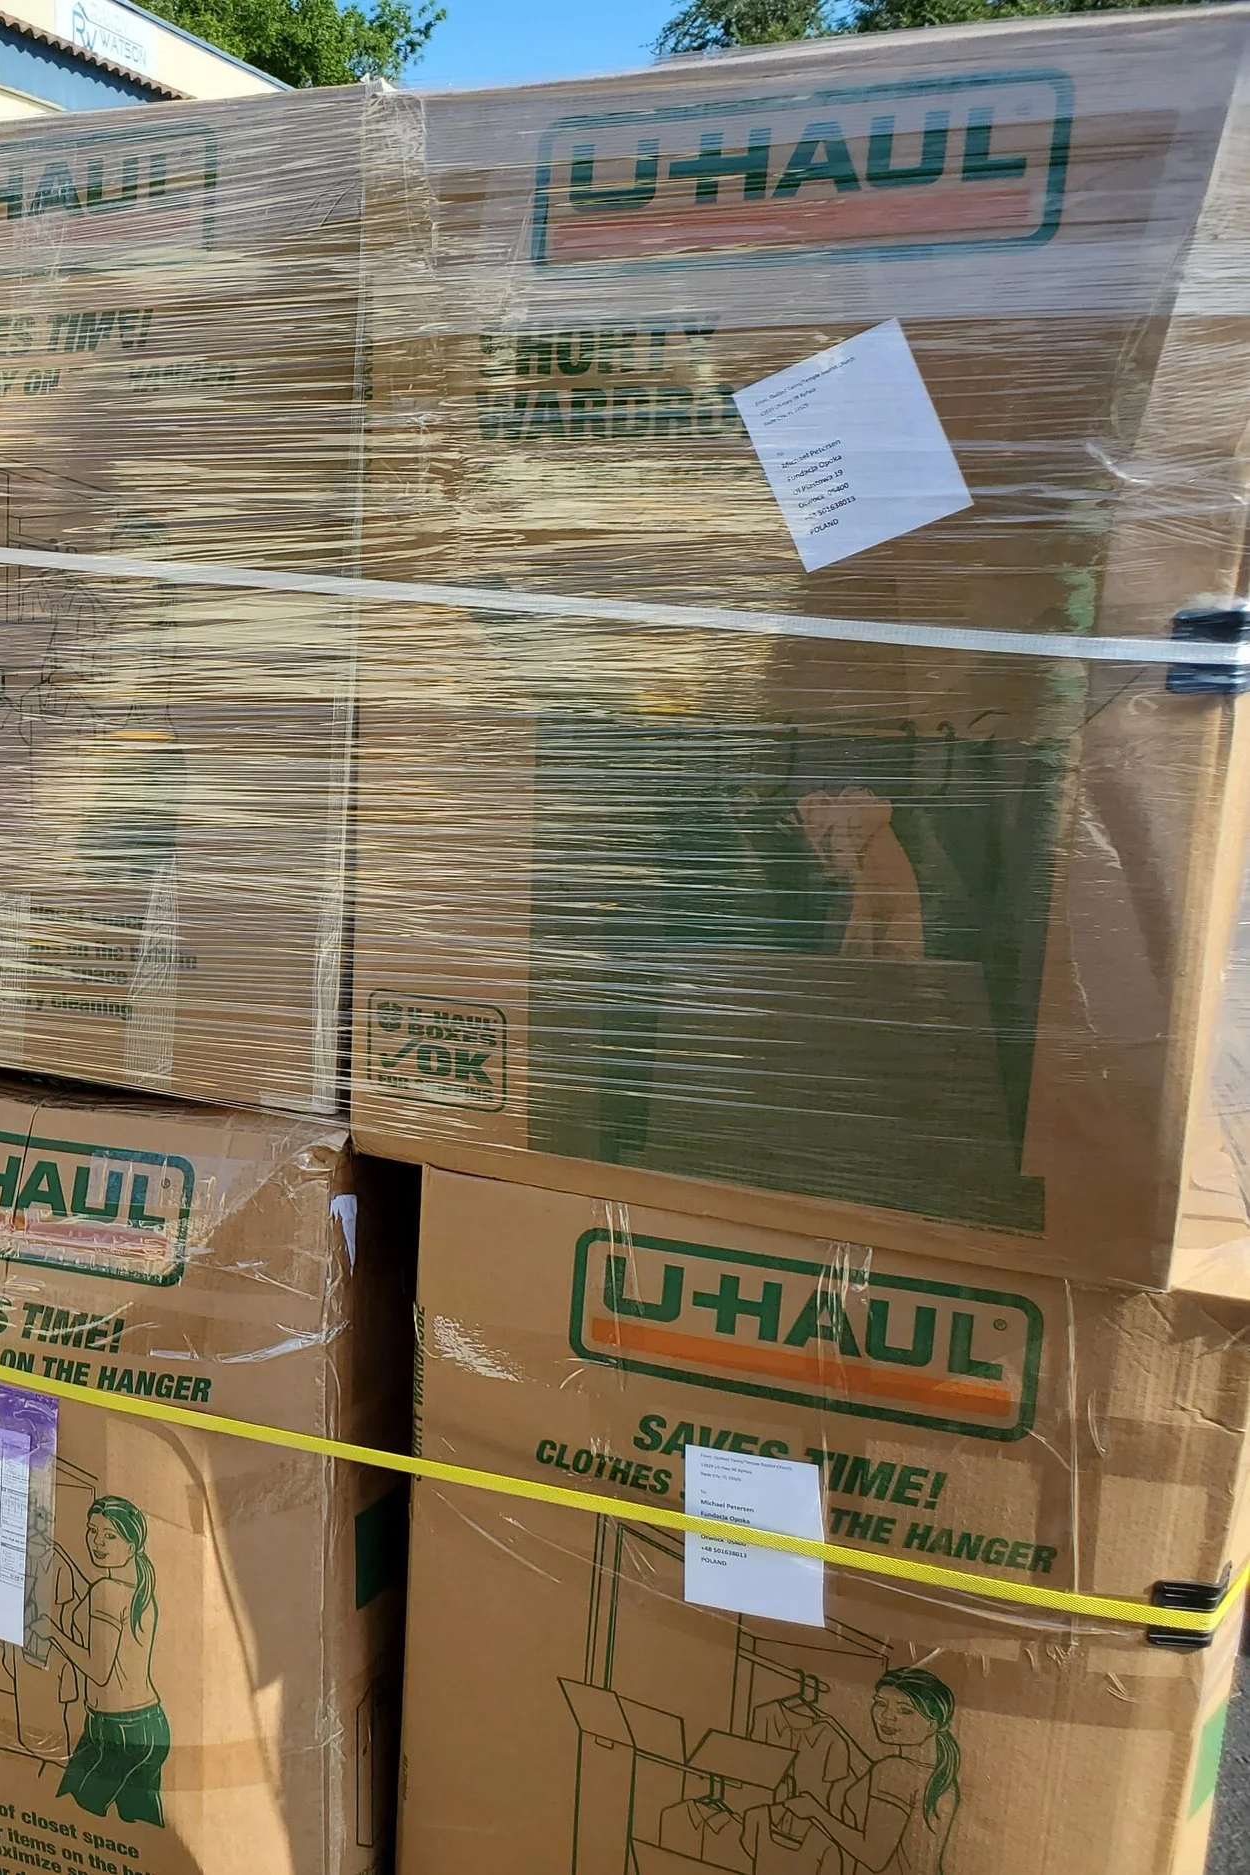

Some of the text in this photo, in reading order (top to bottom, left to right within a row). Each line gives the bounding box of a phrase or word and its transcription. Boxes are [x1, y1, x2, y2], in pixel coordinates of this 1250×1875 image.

[100, 28, 146, 68] WATSON
[569, 104, 1028, 211] U-HAUL
[46, 309, 154, 354] TIME!
[475, 385, 749, 441] WARDRO
[809, 439, 841, 457] Petersen
[809, 518, 839, 535] POLAND
[408, 1023, 497, 1048] BOXES
[417, 1043, 494, 1085] OK
[20, 1302, 125, 1354] TIME!
[604, 1254, 1004, 1380] U-HAUL
[0, 1348, 35, 1373] ON
[43, 1356, 89, 1387] THE
[97, 1366, 212, 1403] HANGER
[536, 1439, 673, 1496] CLOTHES
[805, 1447, 947, 1510] TIME!
[700, 1499, 754, 1513] Michael Petersen
[700, 1511, 750, 1525] Fundacja Opoka
[700, 1557, 726, 1566] POLAND
[830, 1507, 1058, 1574] THE HANGER
[8, 1828, 57, 1855] items
[62, 1848, 84, 1864] on
[88, 1853, 121, 1875] the
[21, 1812, 77, 1839] closet
[82, 1831, 139, 1858] space
